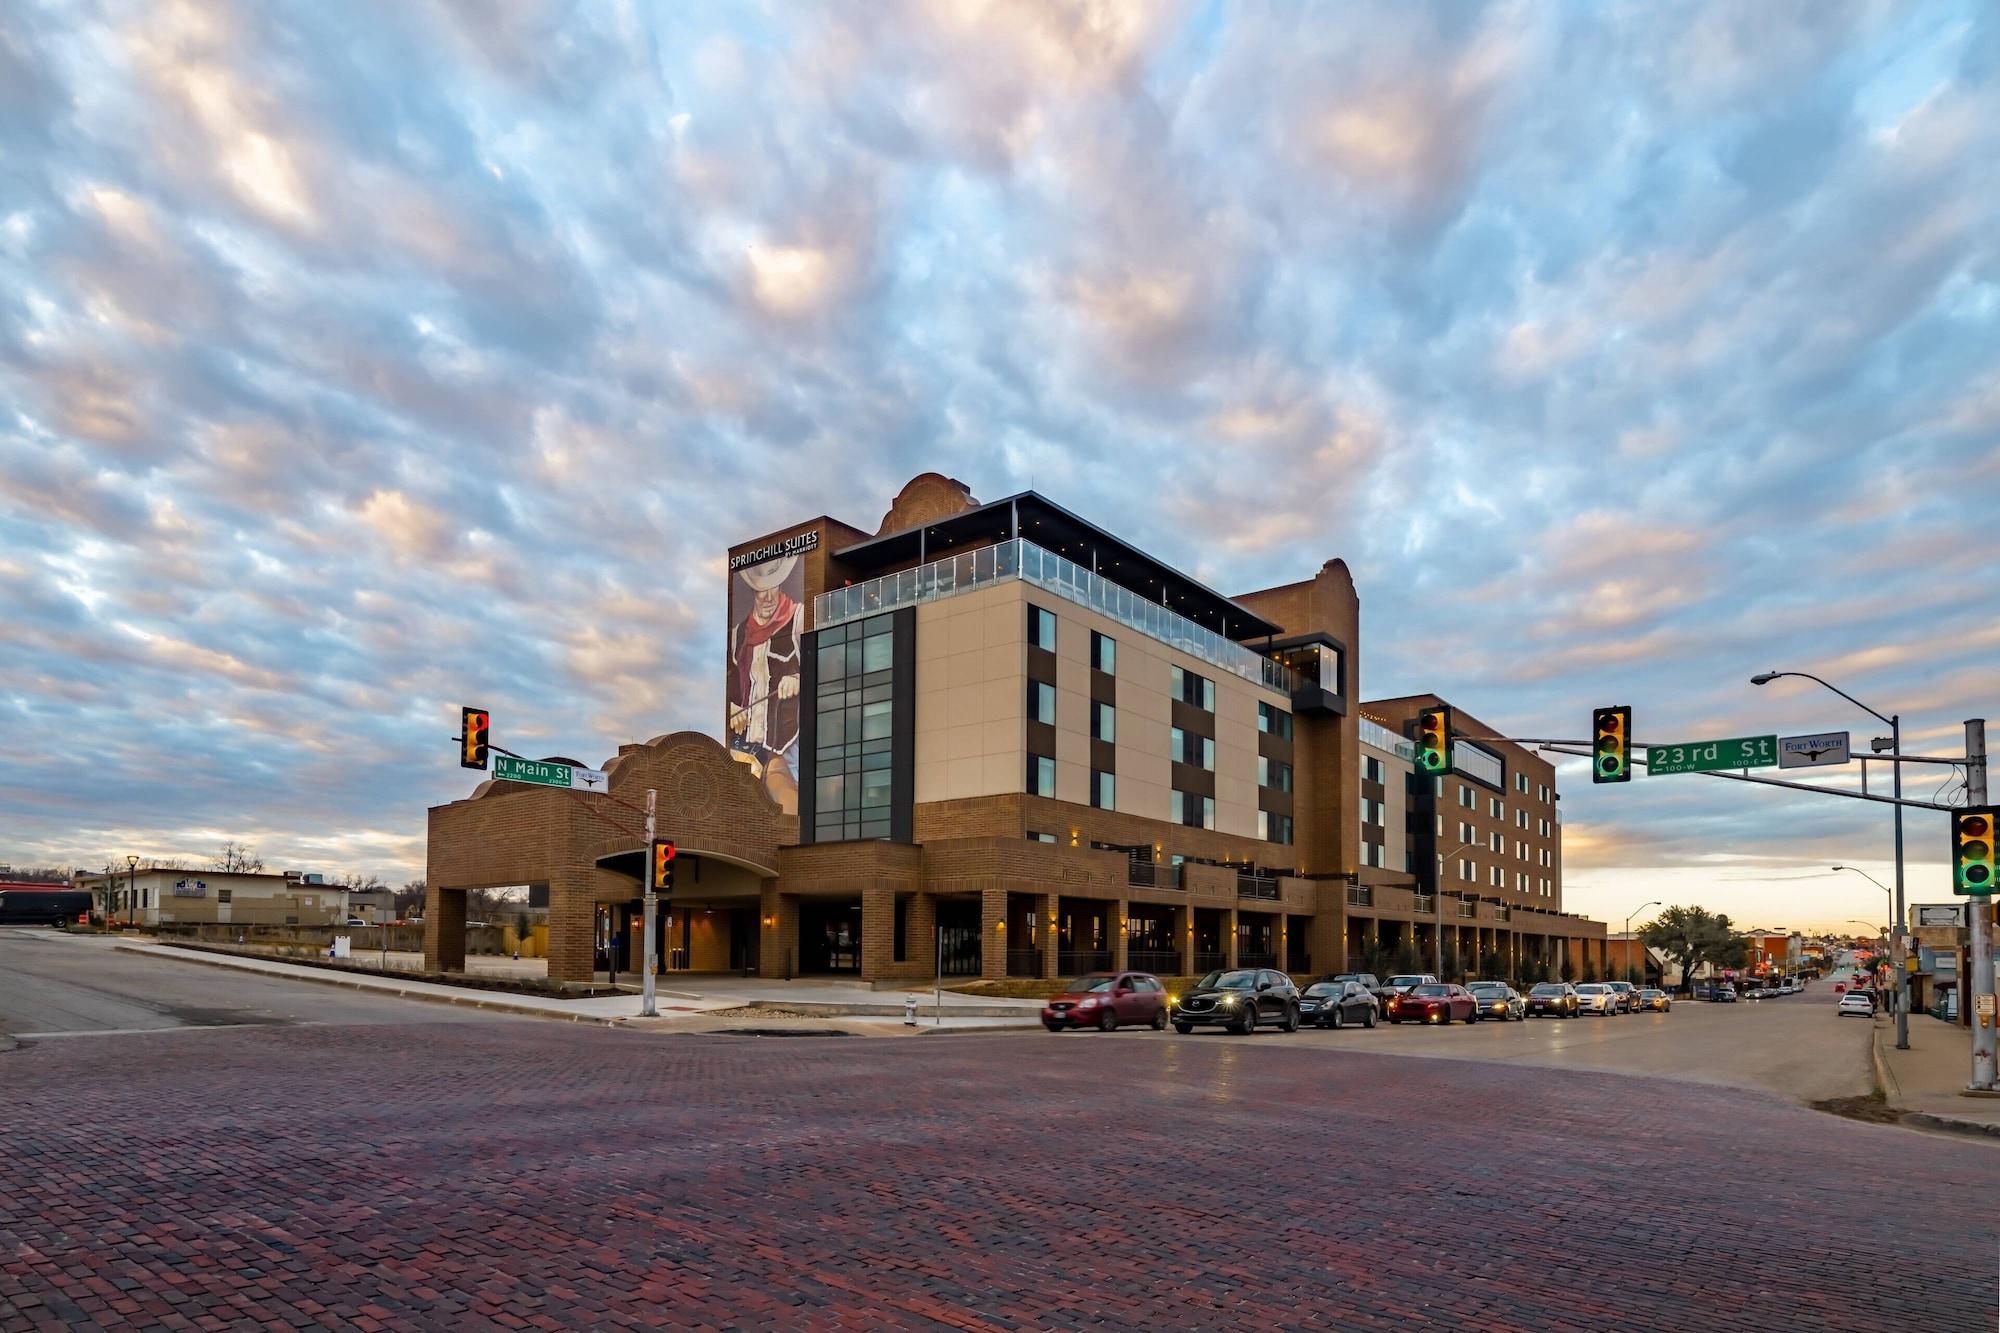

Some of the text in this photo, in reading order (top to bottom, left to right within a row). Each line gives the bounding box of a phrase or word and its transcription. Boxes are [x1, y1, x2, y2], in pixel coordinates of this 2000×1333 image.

[731, 530, 818, 569] SPRINGHILL SUITES
[792, 543, 817, 556] MARRIOTT
[1655, 739, 1769, 765] 23rd St
[1785, 738, 1842, 751] FORT WORTH
[497, 760, 569, 779] N Main St
